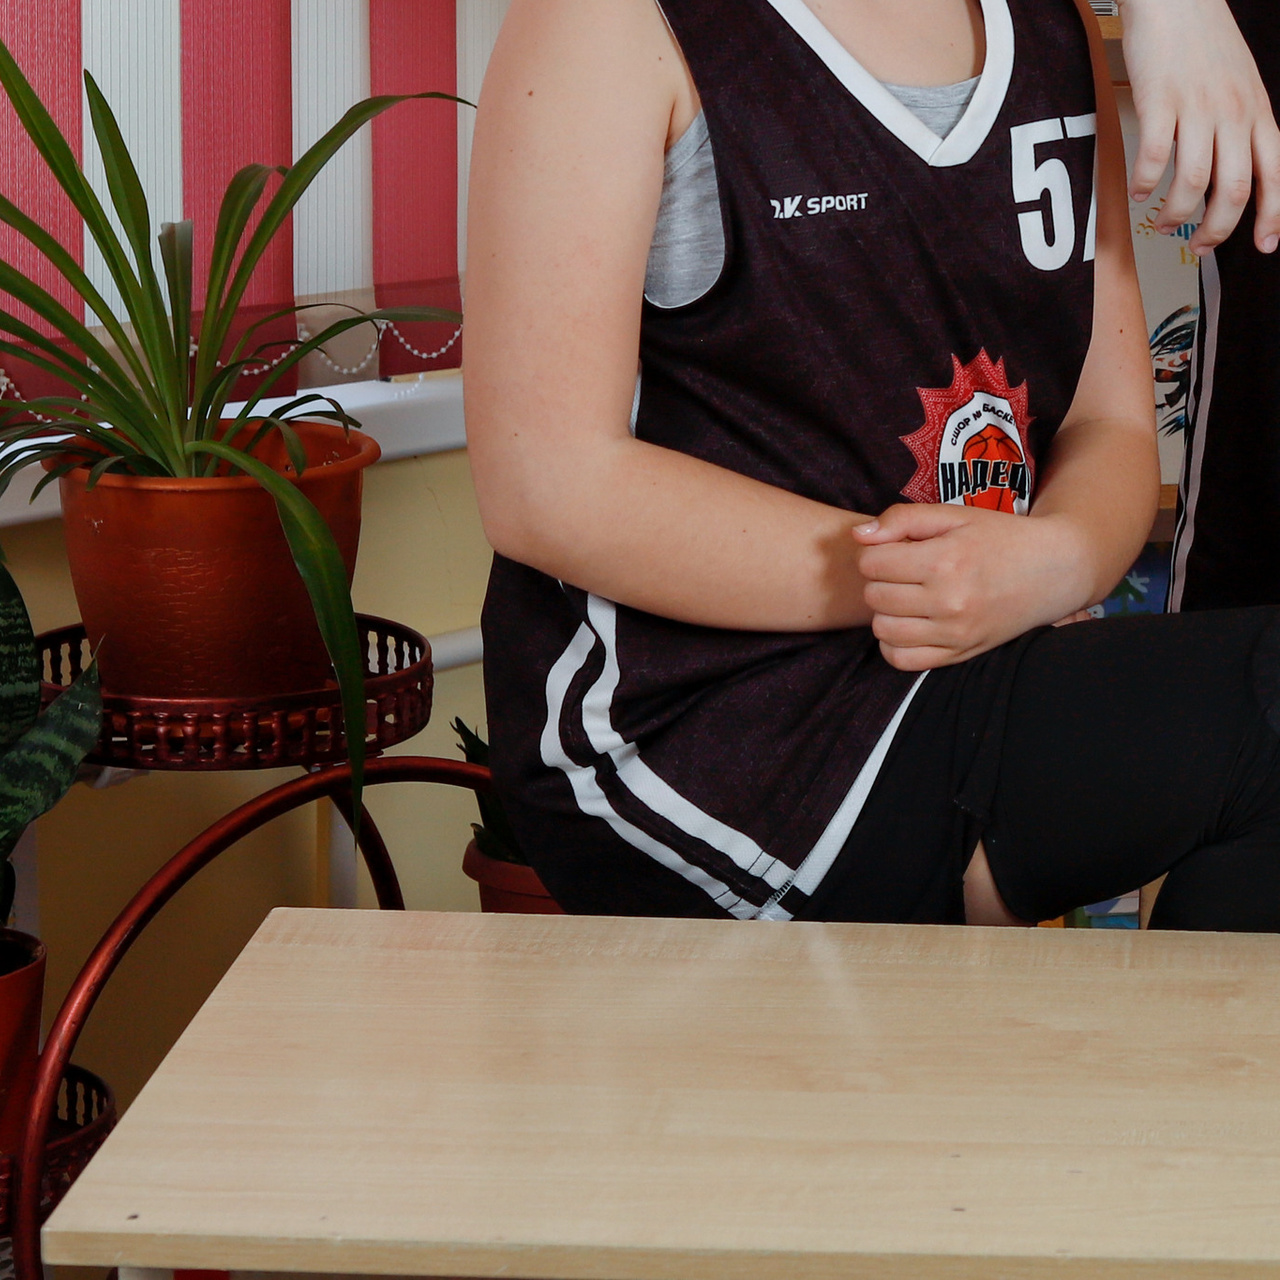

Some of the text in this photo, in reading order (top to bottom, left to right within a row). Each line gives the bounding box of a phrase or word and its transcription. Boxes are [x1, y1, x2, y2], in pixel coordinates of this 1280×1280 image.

[805, 192, 870, 215] SPORT
[951, 417, 971, 447] СШОР
[982, 402, 1016, 426] БАСКЕ
